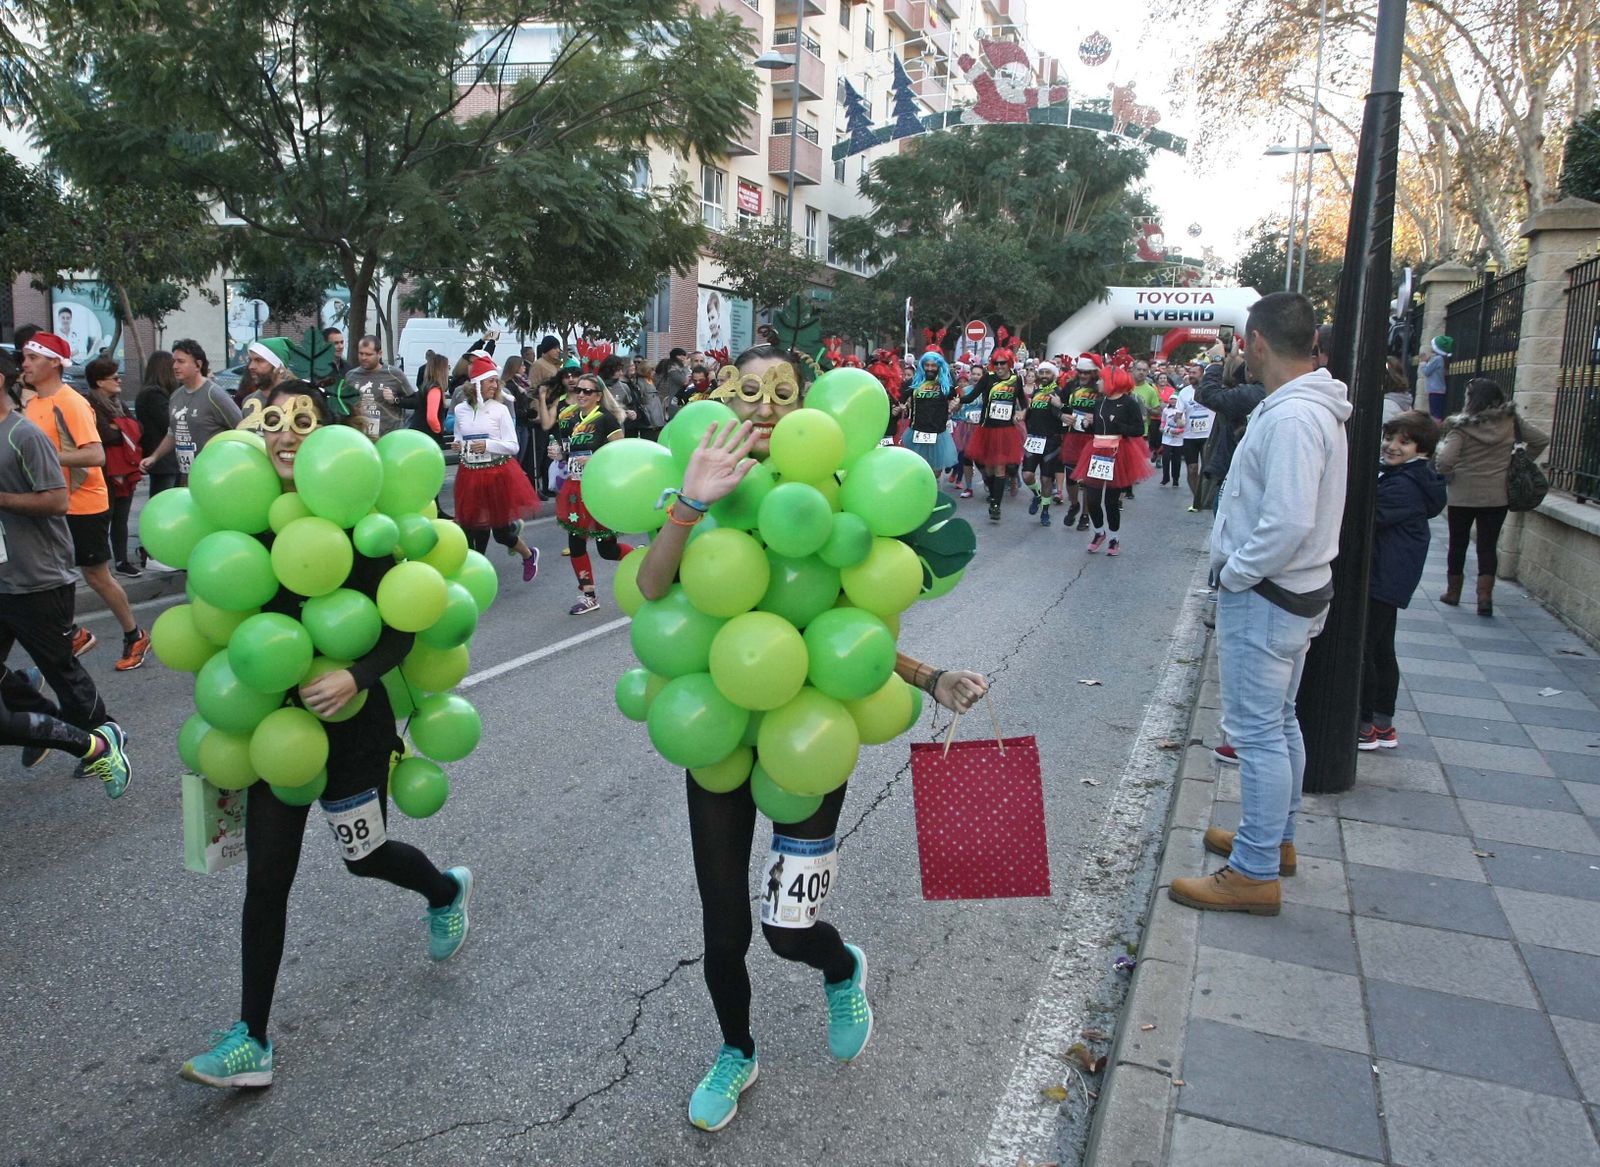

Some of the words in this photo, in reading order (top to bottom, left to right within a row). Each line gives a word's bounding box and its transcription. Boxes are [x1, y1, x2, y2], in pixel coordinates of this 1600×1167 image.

[1136, 292, 1215, 304] TOYOTA
[1134, 309, 1215, 321] HYBRID
[236, 394, 317, 434] 2018
[997, 408, 1009, 416] 419
[1097, 465, 1110, 474] 575
[788, 869, 830, 903] 409
